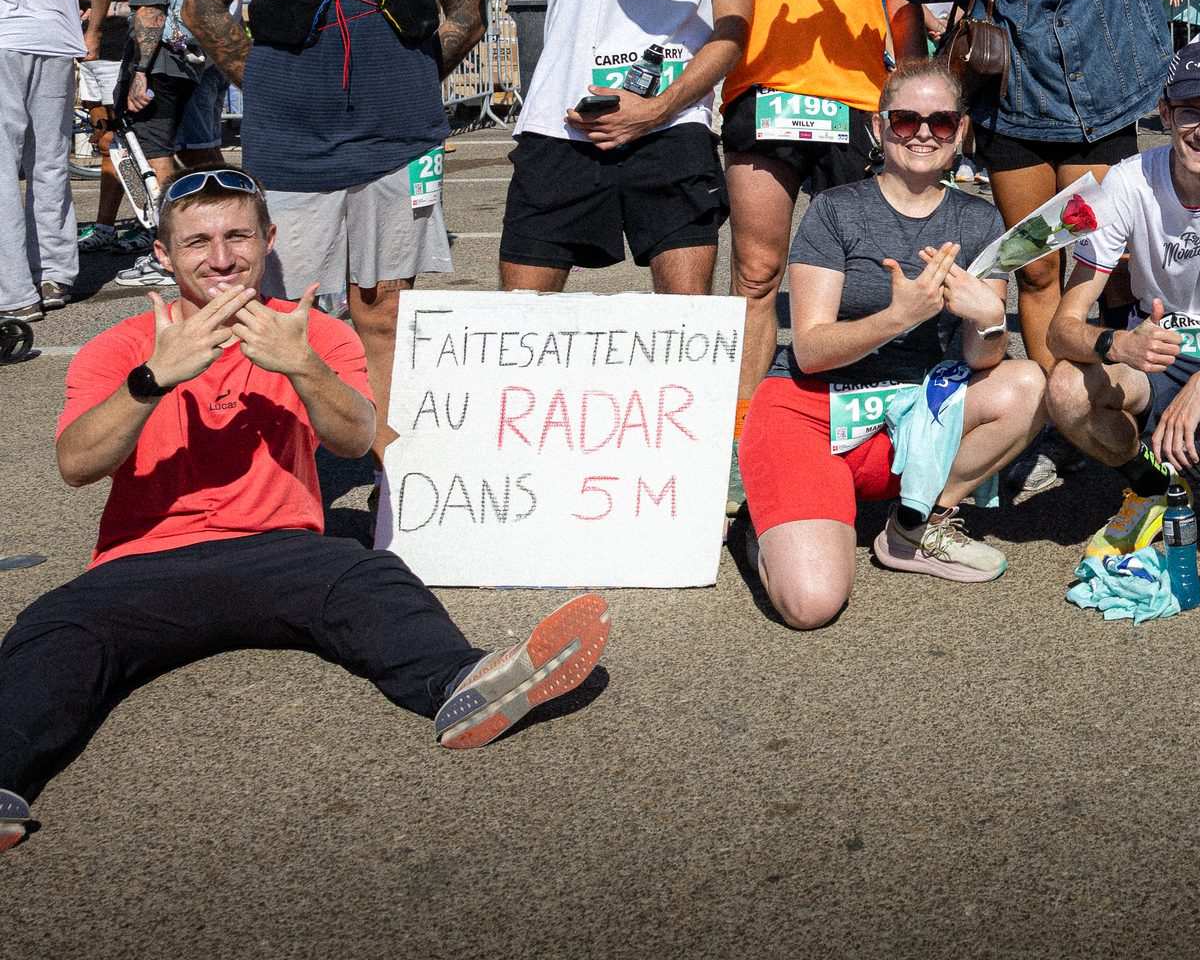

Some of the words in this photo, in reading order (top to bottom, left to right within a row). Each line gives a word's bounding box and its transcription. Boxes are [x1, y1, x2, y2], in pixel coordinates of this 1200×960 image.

[595, 52, 638, 66] CARRO
[769, 96, 838, 116] 1196
[412, 390, 469, 430] AU
[498, 384, 699, 455] RADAR
[398, 472, 537, 532] DANS
[572, 475, 621, 520] 5
[636, 474, 678, 518] M
